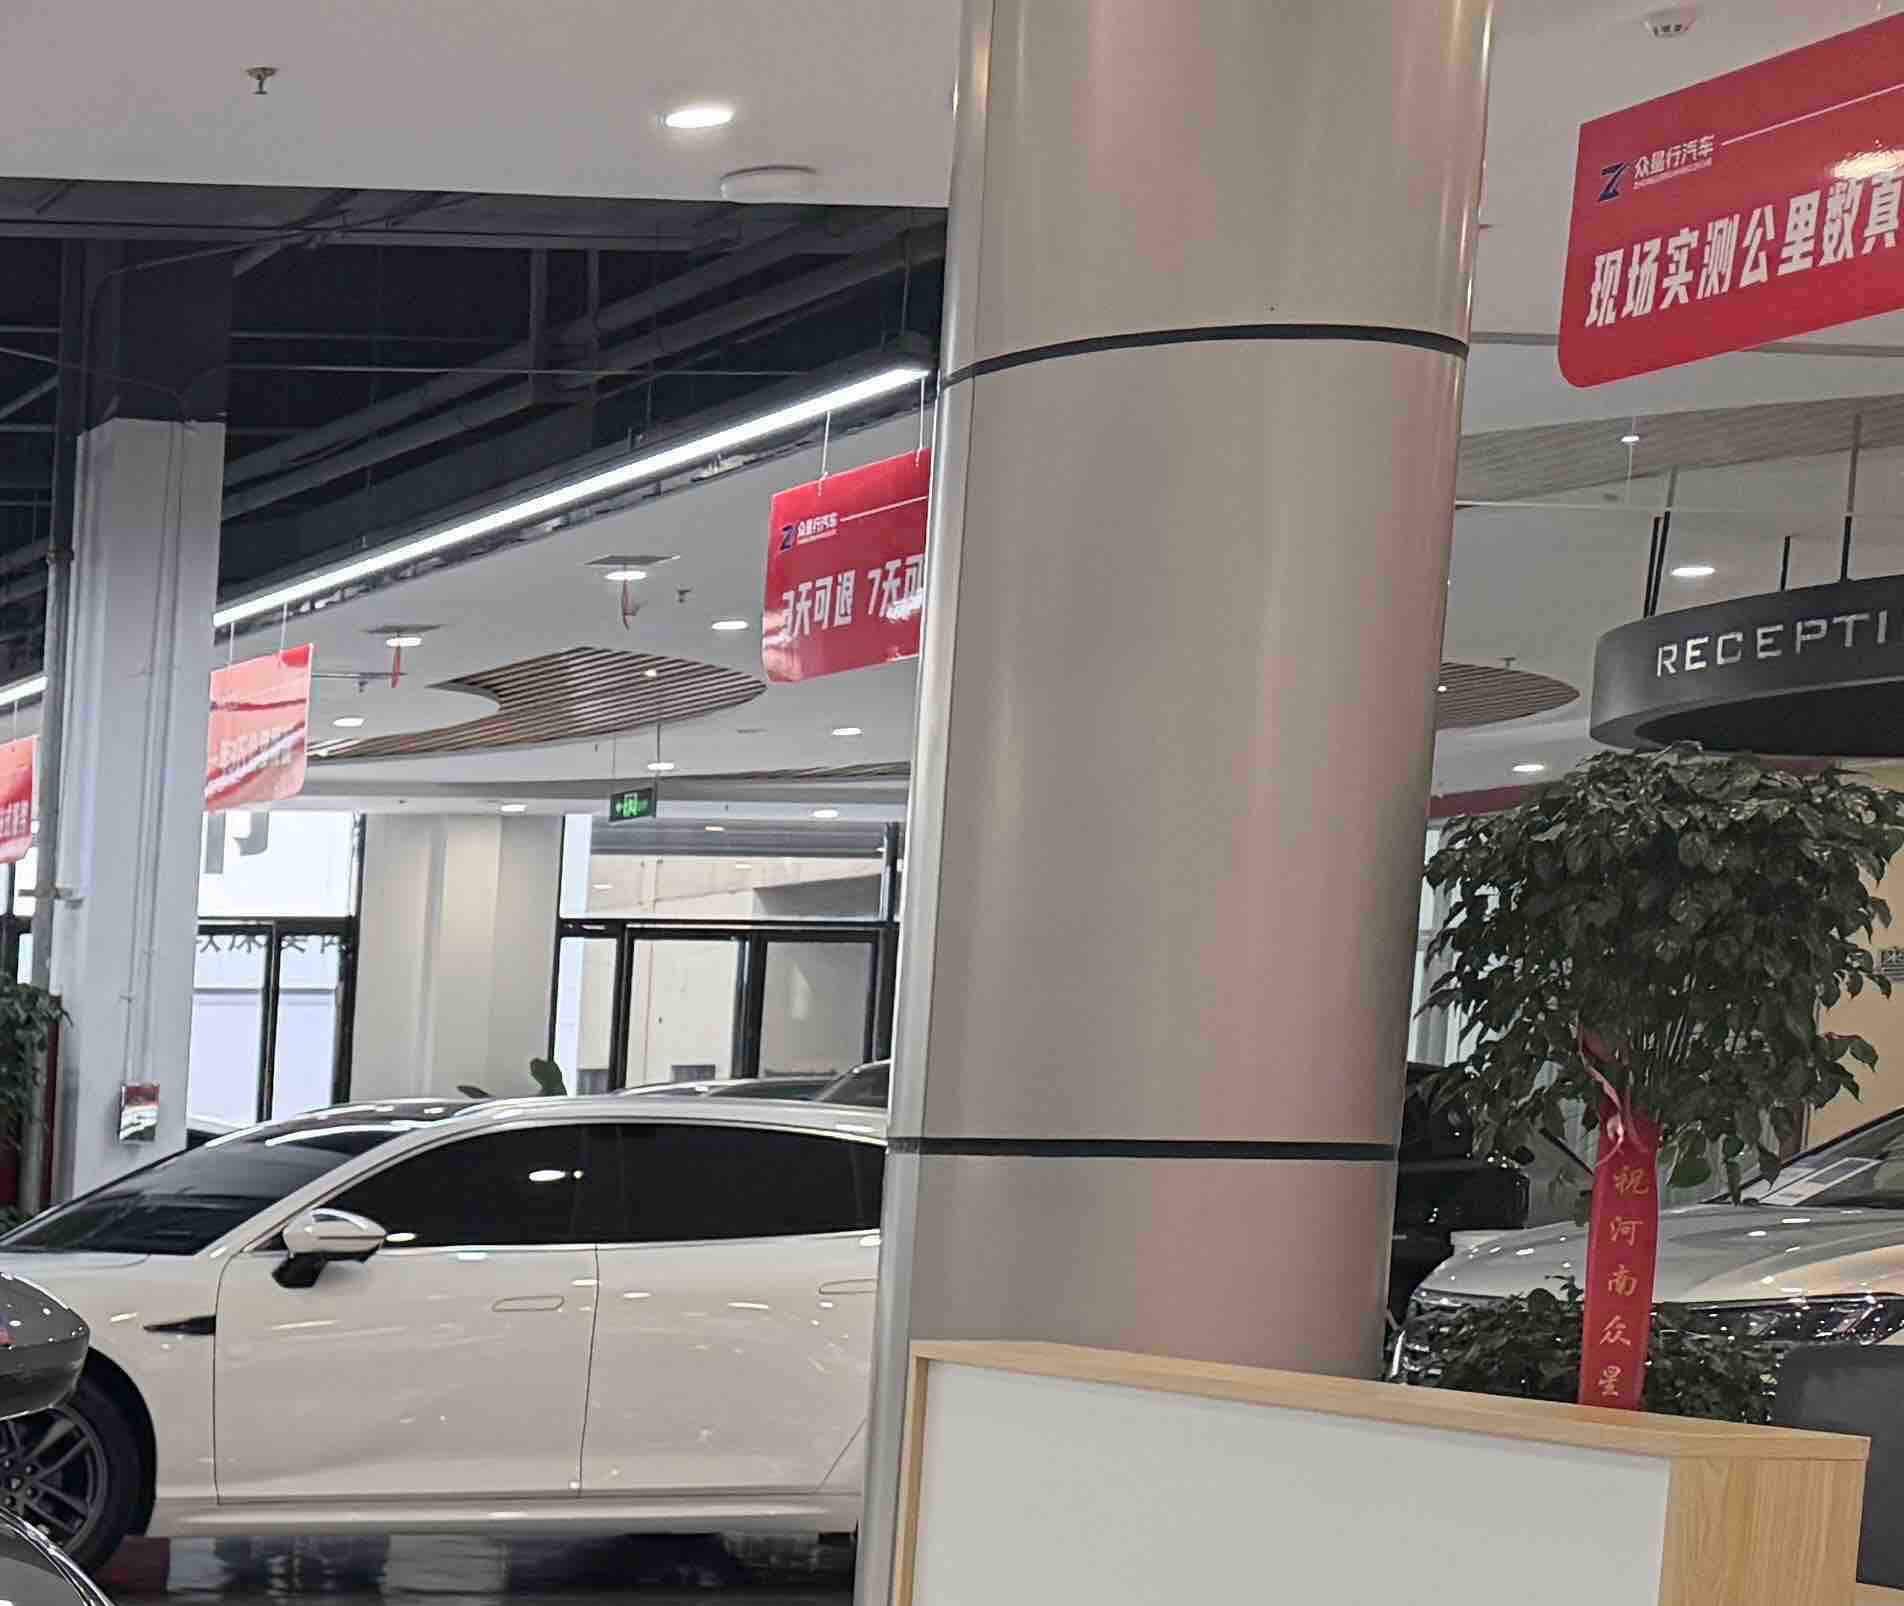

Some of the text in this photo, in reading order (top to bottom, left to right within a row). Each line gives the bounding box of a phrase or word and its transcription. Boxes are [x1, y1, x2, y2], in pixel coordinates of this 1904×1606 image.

[1634, 134, 1715, 179] 众星行汽车
